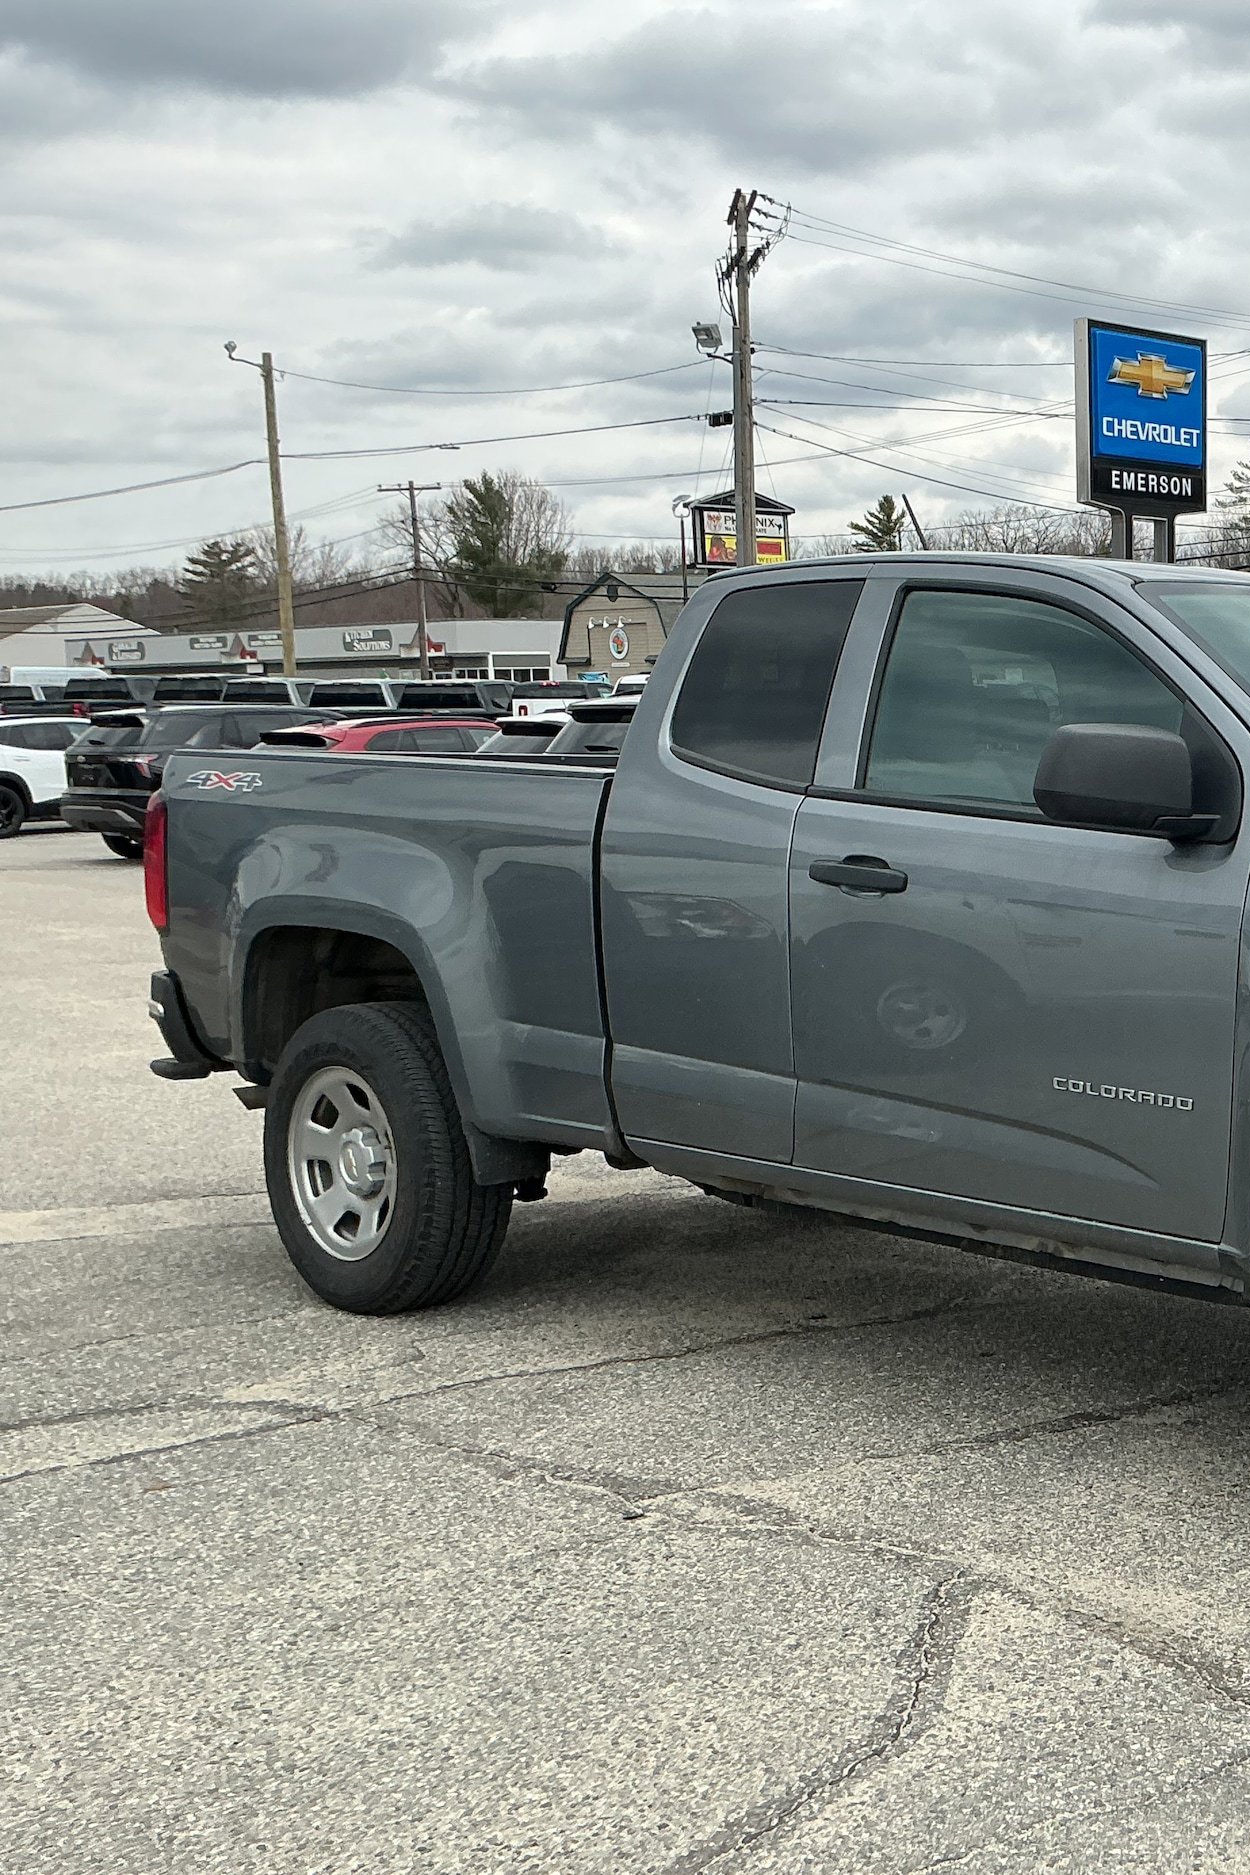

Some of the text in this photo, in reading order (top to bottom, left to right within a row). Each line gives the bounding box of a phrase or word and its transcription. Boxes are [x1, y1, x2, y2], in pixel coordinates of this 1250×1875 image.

[1102, 416, 1200, 448] CHEVROLET
[1111, 469, 1192, 497] EMERSON
[724, 515, 775, 528] PHNIX
[1052, 1076, 1195, 1112] COLORADO
